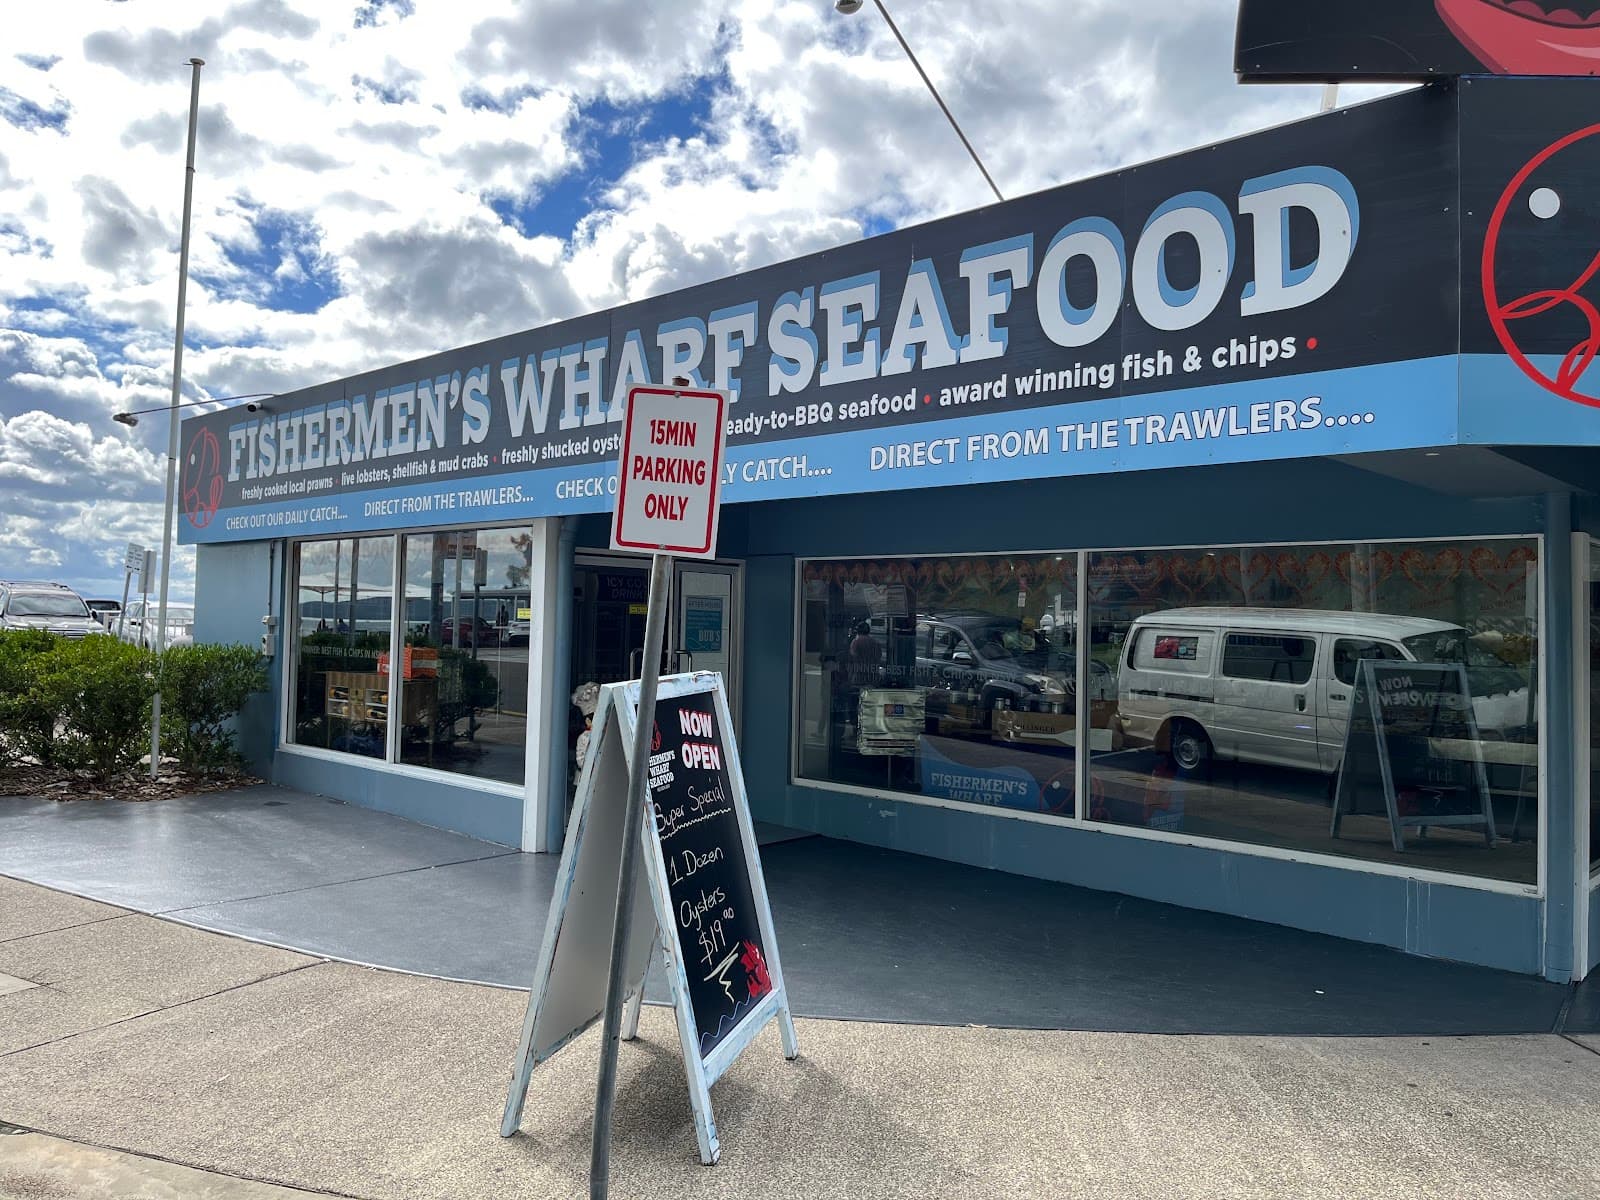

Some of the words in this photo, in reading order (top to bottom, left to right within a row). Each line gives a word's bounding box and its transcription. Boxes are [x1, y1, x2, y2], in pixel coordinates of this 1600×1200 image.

[228, 365, 490, 482] FISHERMEN'S
[500, 302, 758, 438] WHARF
[768, 165, 1360, 396] SEAFOOD
[939, 373, 1007, 407] award
[1014, 361, 1116, 395] winning
[1122, 350, 1173, 382] fish
[1182, 345, 1202, 373] &
[1212, 335, 1297, 368] chips
[726, 401, 834, 437] eady-to-BBQ
[838, 387, 917, 421] seafood
[650, 419, 697, 448] 15MIN
[869, 437, 961, 471] DIRECT
[966, 427, 1050, 462] FROM
[1056, 419, 1119, 453] THE
[501, 444, 539, 465] freshly
[541, 436, 589, 460] shucked
[592, 433, 621, 456] oyst
[341, 472, 355, 487] live
[356, 468, 391, 483] lobsters,
[392, 459, 428, 479] shellfish
[430, 462, 437, 474] &
[438, 455, 459, 473] mud
[461, 452, 489, 470] crabs
[632, 455, 706, 486] PARKING
[241, 485, 263, 500] freshly
[264, 483, 288, 496] cooked
[289, 479, 306, 493] local
[307, 477, 333, 494] prawns
[556, 476, 604, 500] CHECK
[226, 515, 249, 531] CHECK
[250, 513, 266, 528] OUT
[267, 511, 284, 527] OUR
[285, 509, 309, 525] DAILY
[364, 498, 400, 518] DIRECT
[401, 496, 432, 514] FROM
[433, 493, 456, 510] THE
[644, 493, 689, 521] ONLY
[679, 708, 713, 738] NOW
[649, 749, 676, 767] HERMEN'S
[649, 762, 670, 777] WHARF
[681, 740, 721, 770] OPEN
[649, 771, 675, 789] SEAFOOD
[931, 773, 1027, 795] FISHERMEN'S
[653, 802, 686, 832] Super
[687, 775, 727, 814] Special
[669, 855, 684, 887] 1
[682, 846, 724, 876] Dozen
[680, 886, 727, 931] Oysters
